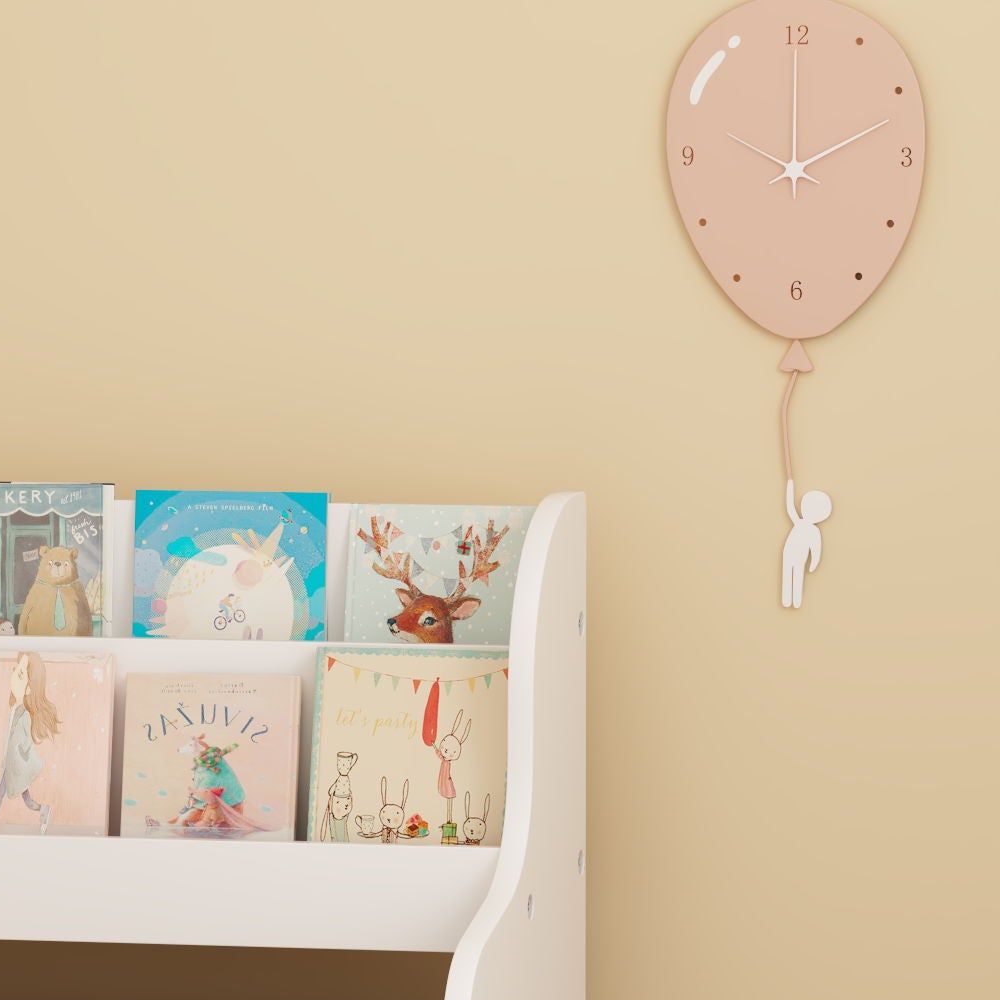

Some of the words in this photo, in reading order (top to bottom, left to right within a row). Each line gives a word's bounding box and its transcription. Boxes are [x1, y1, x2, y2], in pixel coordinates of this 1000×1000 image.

[785, 25, 809, 46] 12
[681, 145, 694, 167] 9
[901, 147, 913, 168] 3
[790, 280, 803, 301] 6
